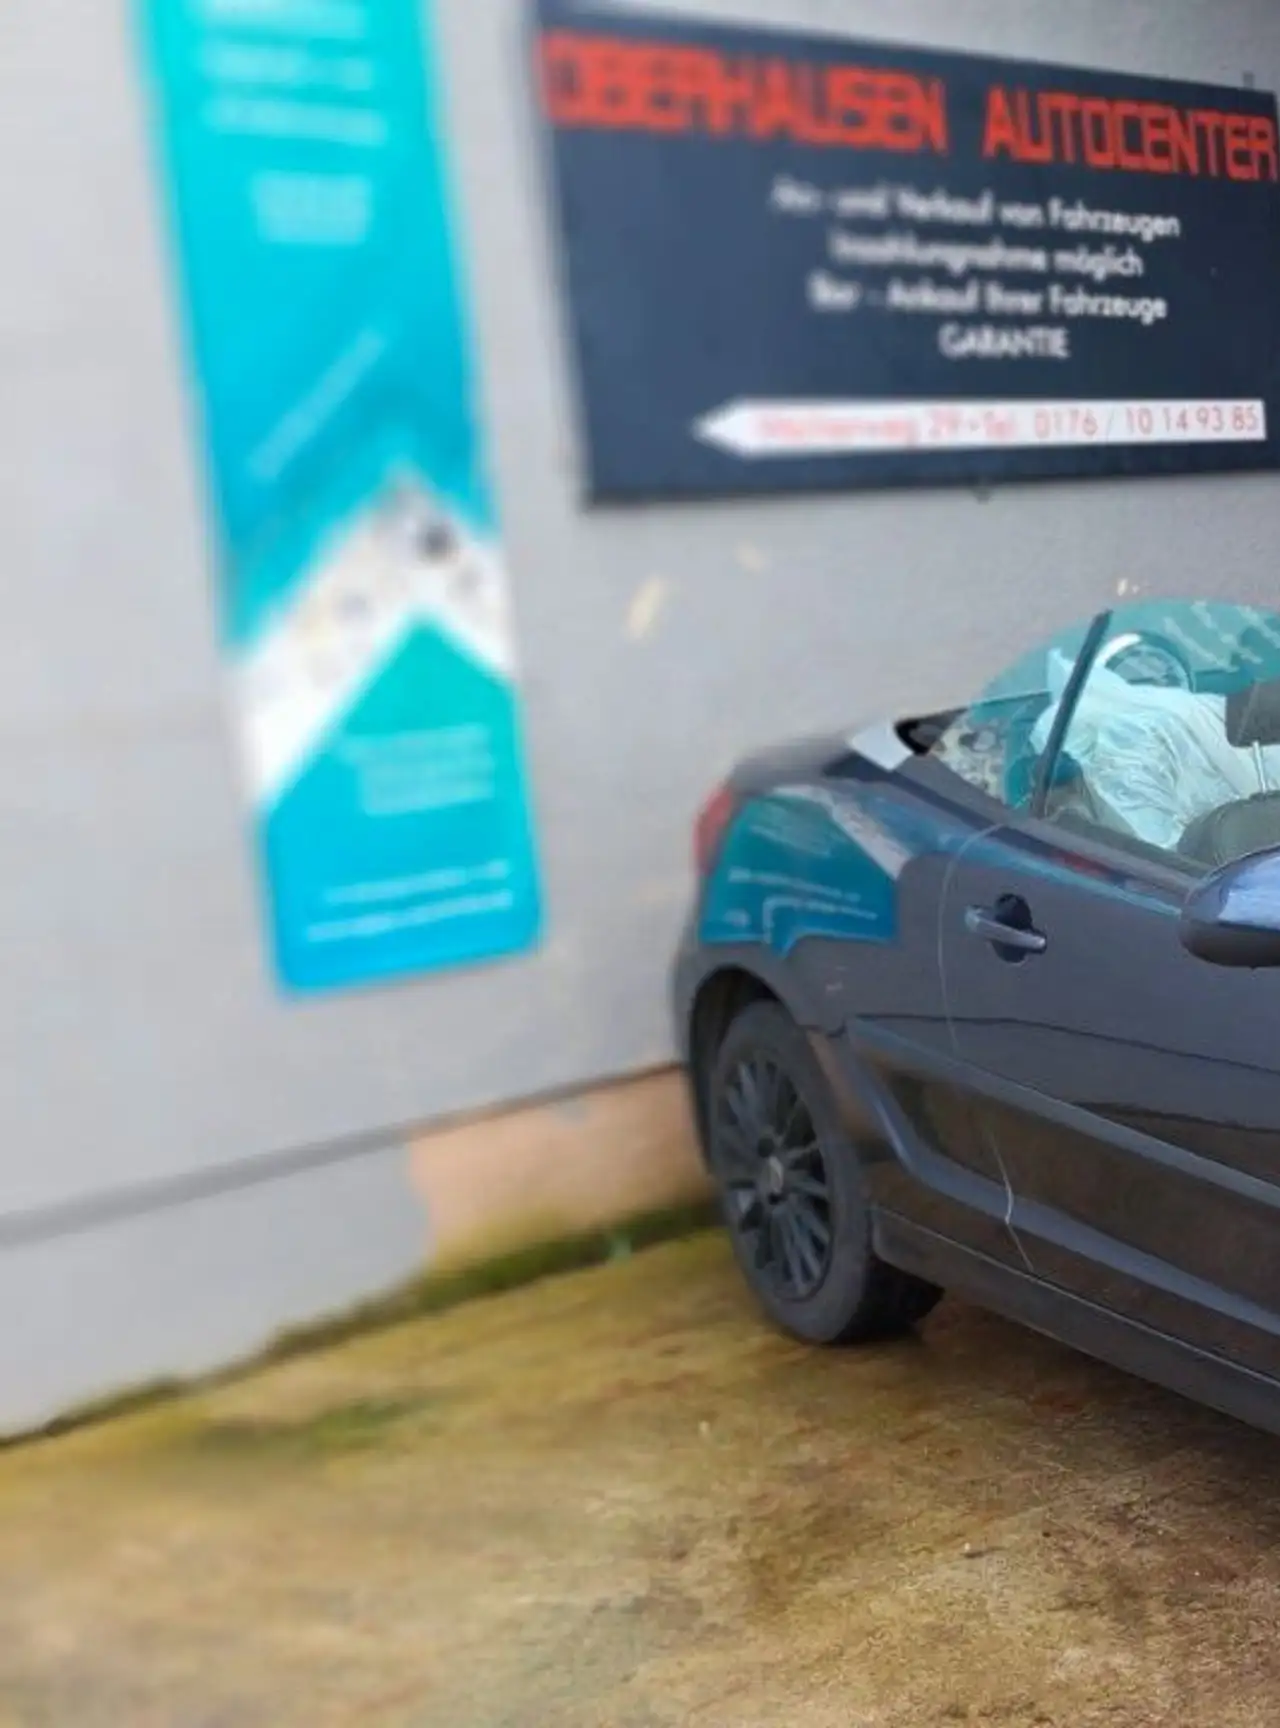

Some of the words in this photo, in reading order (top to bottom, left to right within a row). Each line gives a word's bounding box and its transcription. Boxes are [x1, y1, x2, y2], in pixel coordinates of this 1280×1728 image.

[541, 34, 948, 154] OBERHAUSEN
[982, 86, 1277, 182] AUTOCENTER
[896, 186, 994, 225] Verkauf
[1000, 202, 1044, 229] von
[1048, 195, 1182, 244] Fahrzeugen
[1053, 244, 1144, 283] möglich
[887, 279, 979, 315] Ankauf
[1049, 284, 1168, 326] Fahrzeuge
[938, 322, 1070, 359] GARANTIE
[1034, 409, 1098, 437] 0176
[1125, 408, 1153, 434] 10
[1163, 407, 1188, 433] 14
[1195, 407, 1223, 432] 93
[1232, 406, 1259, 430] 85
